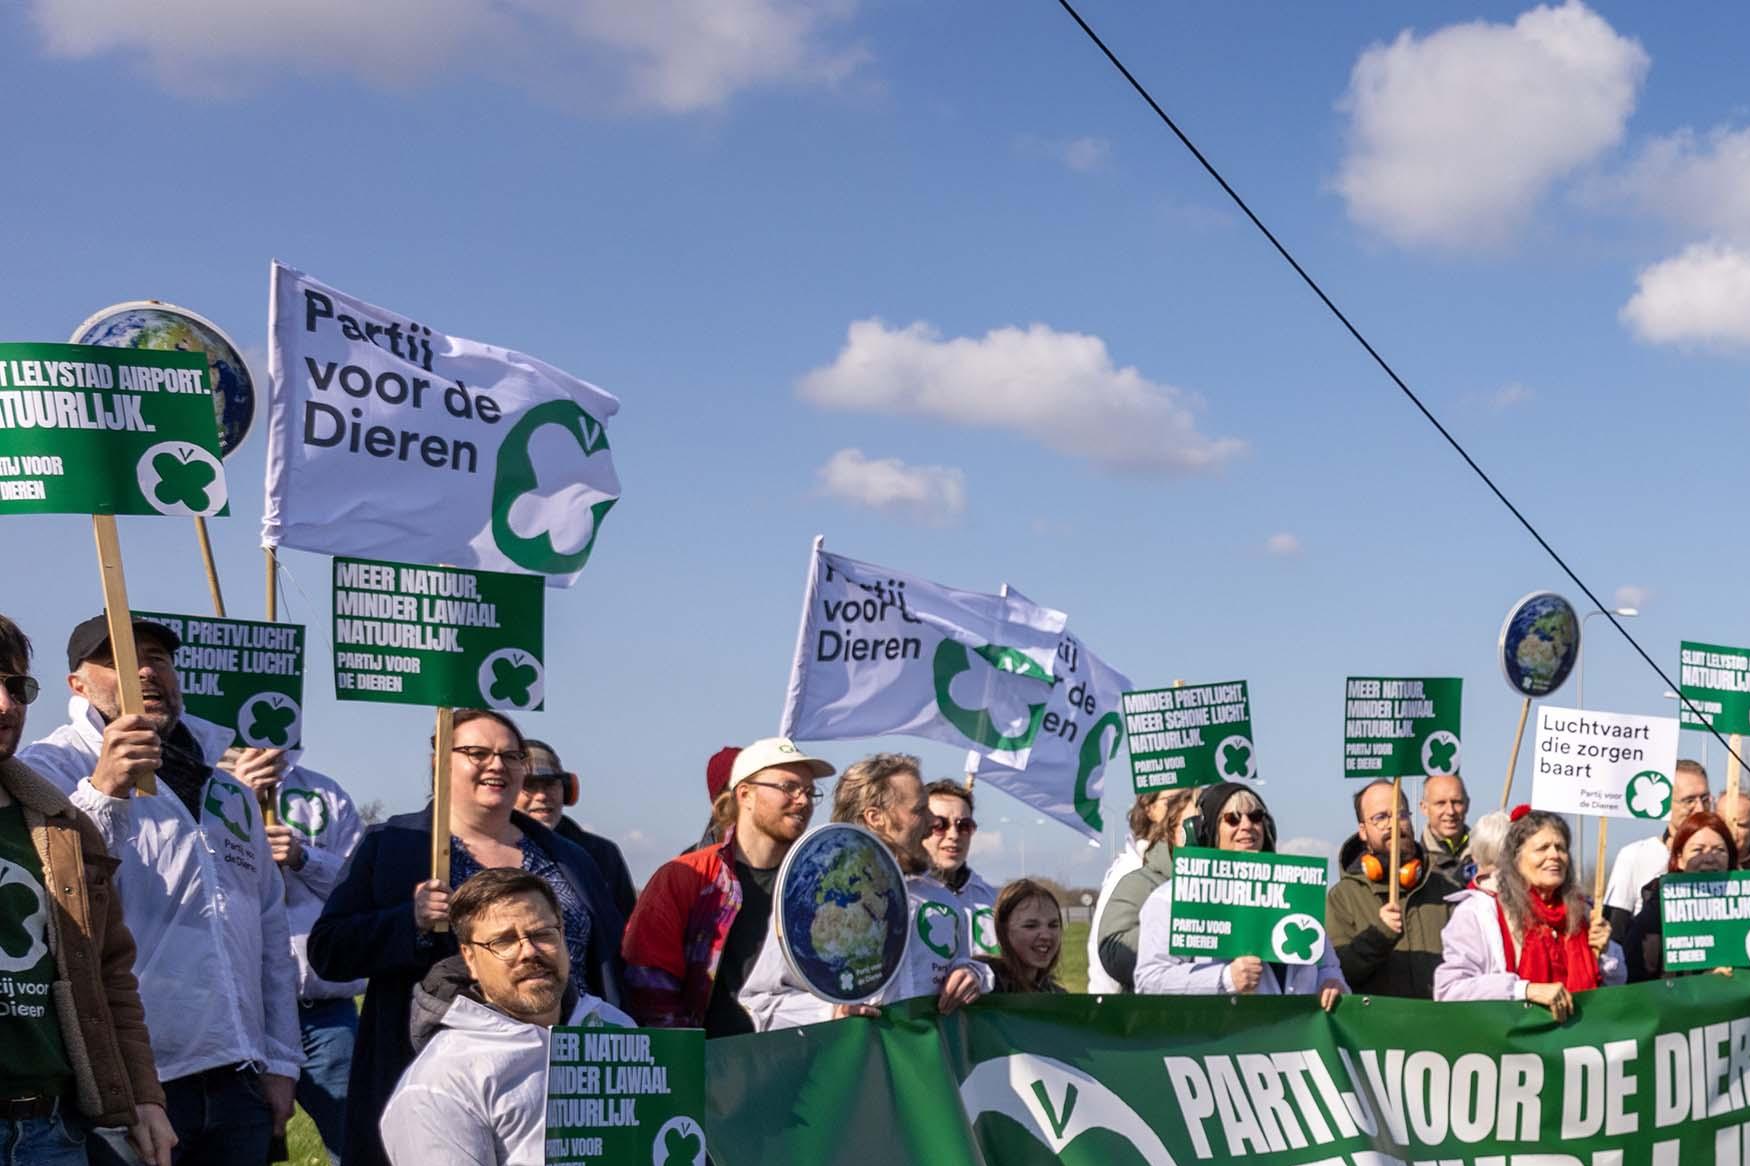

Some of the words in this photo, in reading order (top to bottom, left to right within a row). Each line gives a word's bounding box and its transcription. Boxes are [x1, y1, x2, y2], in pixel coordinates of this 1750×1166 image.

[304, 288, 433, 372] Partij
[10, 361, 114, 389] LELYSTAD
[119, 366, 211, 394] AIRPORT.
[304, 356, 431, 408] voor
[444, 380, 502, 424] de
[304, 400, 478, 473] Dieren
[22, 456, 64, 475] VOOR
[336, 562, 396, 592] MEER
[400, 568, 482, 602] NATUUR,
[336, 591, 418, 621] MINDER
[423, 598, 501, 628] LAWAAI.
[188, 621, 301, 653] PRETVLUCHT,
[337, 619, 464, 653] NATUURLIJK.
[817, 629, 922, 662] Dieren
[242, 651, 300, 676] LUCHT.
[337, 652, 383, 671] PARTIJ
[386, 655, 421, 674] VOOR
[338, 672, 355, 689] DE
[357, 674, 403, 692] DIEREN
[1347, 680, 1380, 698] MEER
[1068, 681, 1096, 715] de
[1124, 691, 1174, 714] MINDER
[1347, 700, 1392, 718] MINDER
[1127, 712, 1164, 734] MEER
[1164, 707, 1210, 730] SCHONE
[1210, 703, 1249, 724] LUCHT.
[1346, 720, 1415, 738] NATUURLIJK.
[1543, 714, 1650, 740] Luchtvaart
[1541, 736, 1570, 754] die
[1577, 743, 1644, 763] zorgen
[1540, 757, 1592, 778] baart
[1175, 857, 1210, 877] SLUIT
[1212, 859, 1271, 881] LELYSTAD
[1273, 864, 1327, 886] AIRPORT.
[1174, 876, 1291, 909] NATUURLIJK.
[1173, 918, 1205, 932] PARTIJ
[1207, 920, 1232, 934] VOOR
[1172, 933, 1184, 947] DE
[1186, 935, 1218, 949] DIEREN
[17, 983, 49, 995] voor
[584, 1034, 655, 1066] NATUUR,
[605, 1066, 671, 1094] LAWAAI.
[1164, 1047, 1379, 1159] PARTIJ
[1359, 1049, 1543, 1146] VOOR
[1561, 1040, 1639, 1141] DE
[571, 1137, 603, 1156] VOOR
